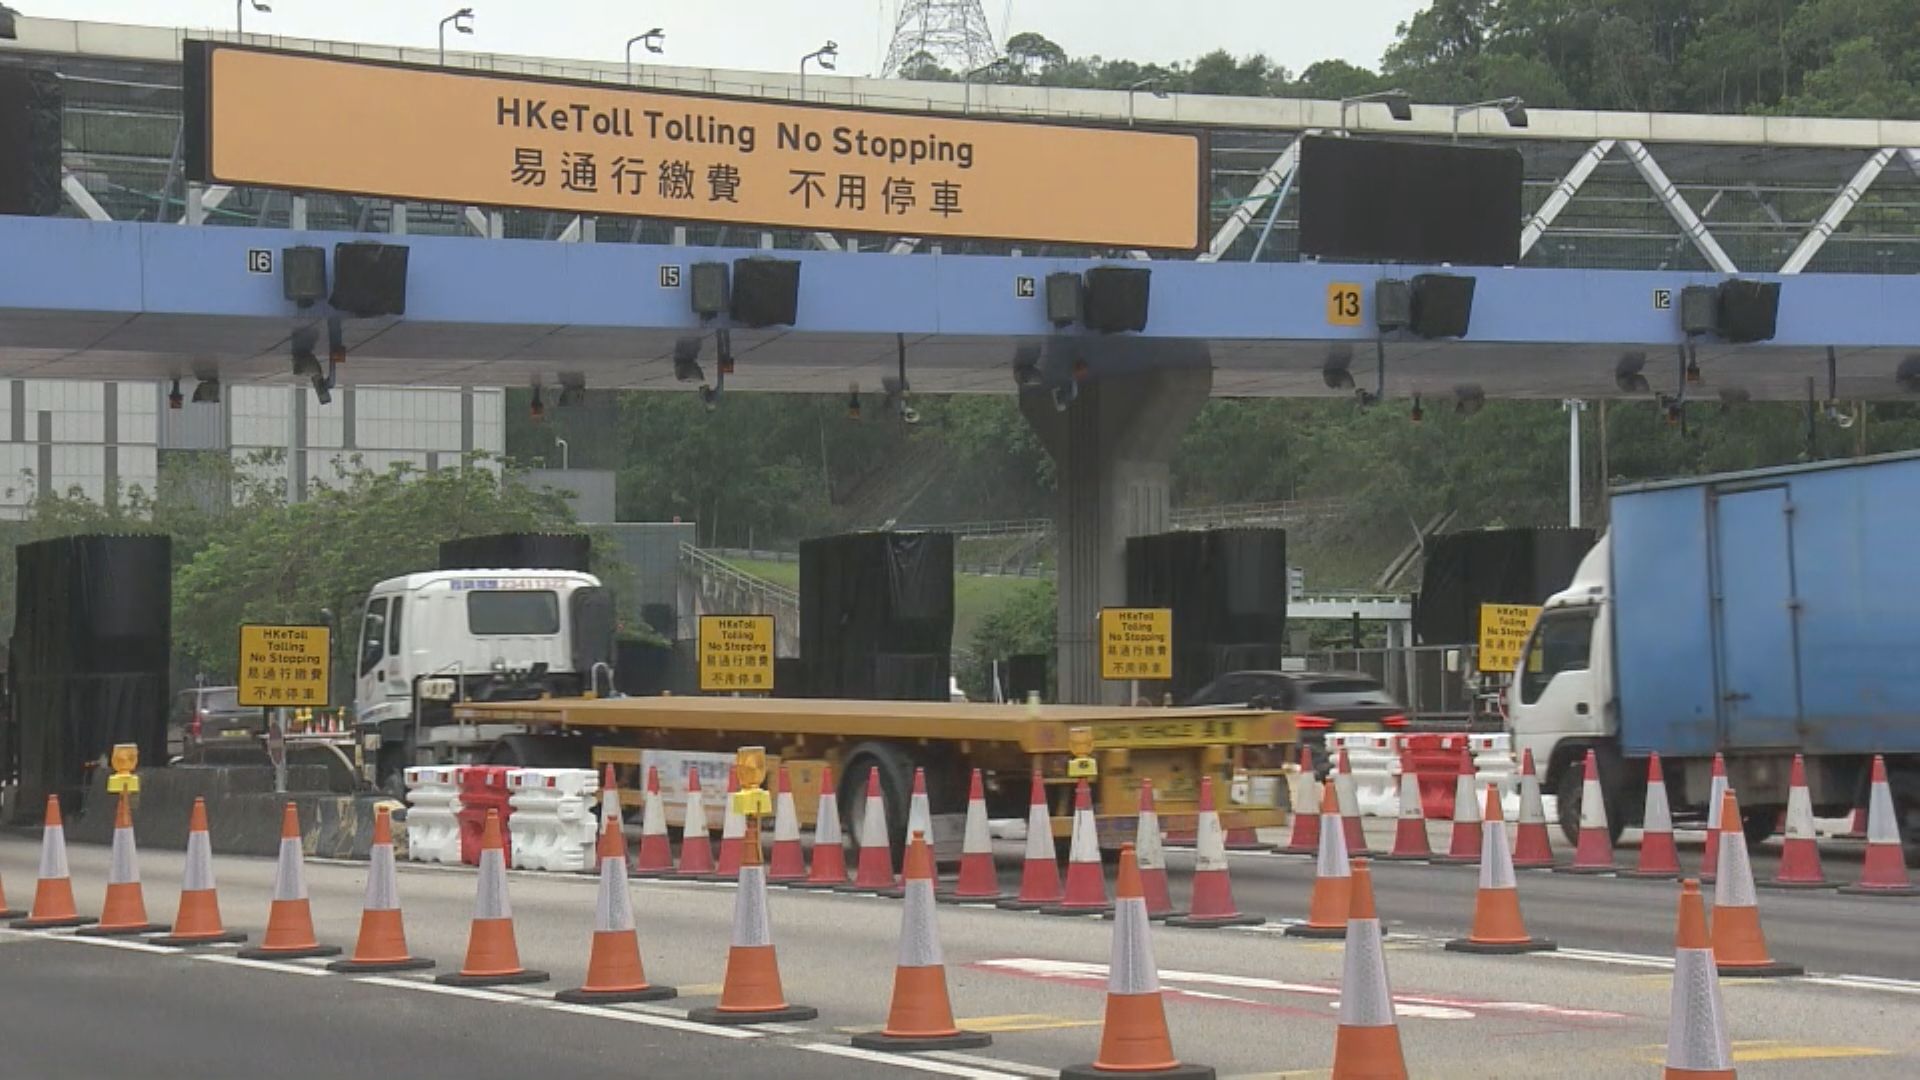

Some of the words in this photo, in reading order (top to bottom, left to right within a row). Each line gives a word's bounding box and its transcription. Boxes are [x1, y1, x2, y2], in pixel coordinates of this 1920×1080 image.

[496, 96, 634, 137] HKeToll
[643, 109, 756, 153] Tolling
[777, 121, 822, 152] No
[832, 126, 974, 169] Stopping
[511, 147, 741, 203] 易通行繳費
[788, 169, 964, 218] 不用停車
[250, 251, 271, 271] 16
[662, 267, 679, 285] 15
[1019, 279, 1033, 295] 14
[1332, 290, 1360, 317] 13
[1656, 291, 1670, 308] 12
[1108, 632, 1122, 641] No
[708, 642, 722, 651] No
[250, 652, 266, 662] No
